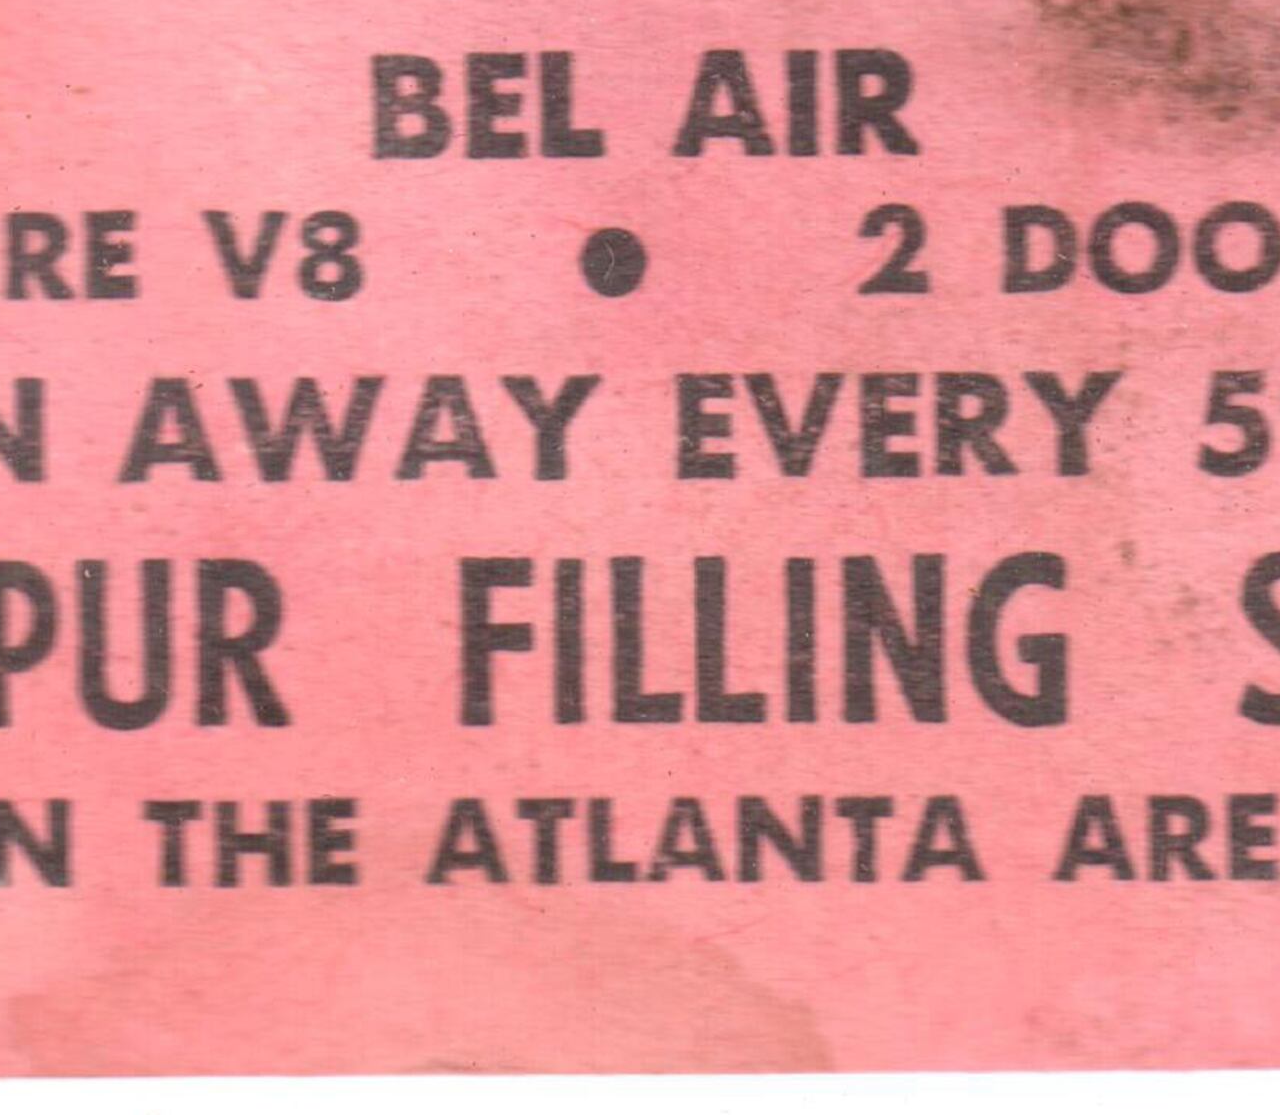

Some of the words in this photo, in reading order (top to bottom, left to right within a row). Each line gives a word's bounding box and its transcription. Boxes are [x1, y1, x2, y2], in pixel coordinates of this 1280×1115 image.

[371, 50, 607, 161] BEL
[671, 48, 921, 158] AIR
[204, 210, 364, 302] V8
[857, 203, 930, 296] 2
[119, 375, 601, 483] AWAY
[676, 370, 1123, 480] EVERY
[459, 551, 1069, 729] FILLING
[144, 797, 359, 889] THE
[425, 795, 986, 886] ATLANTA
